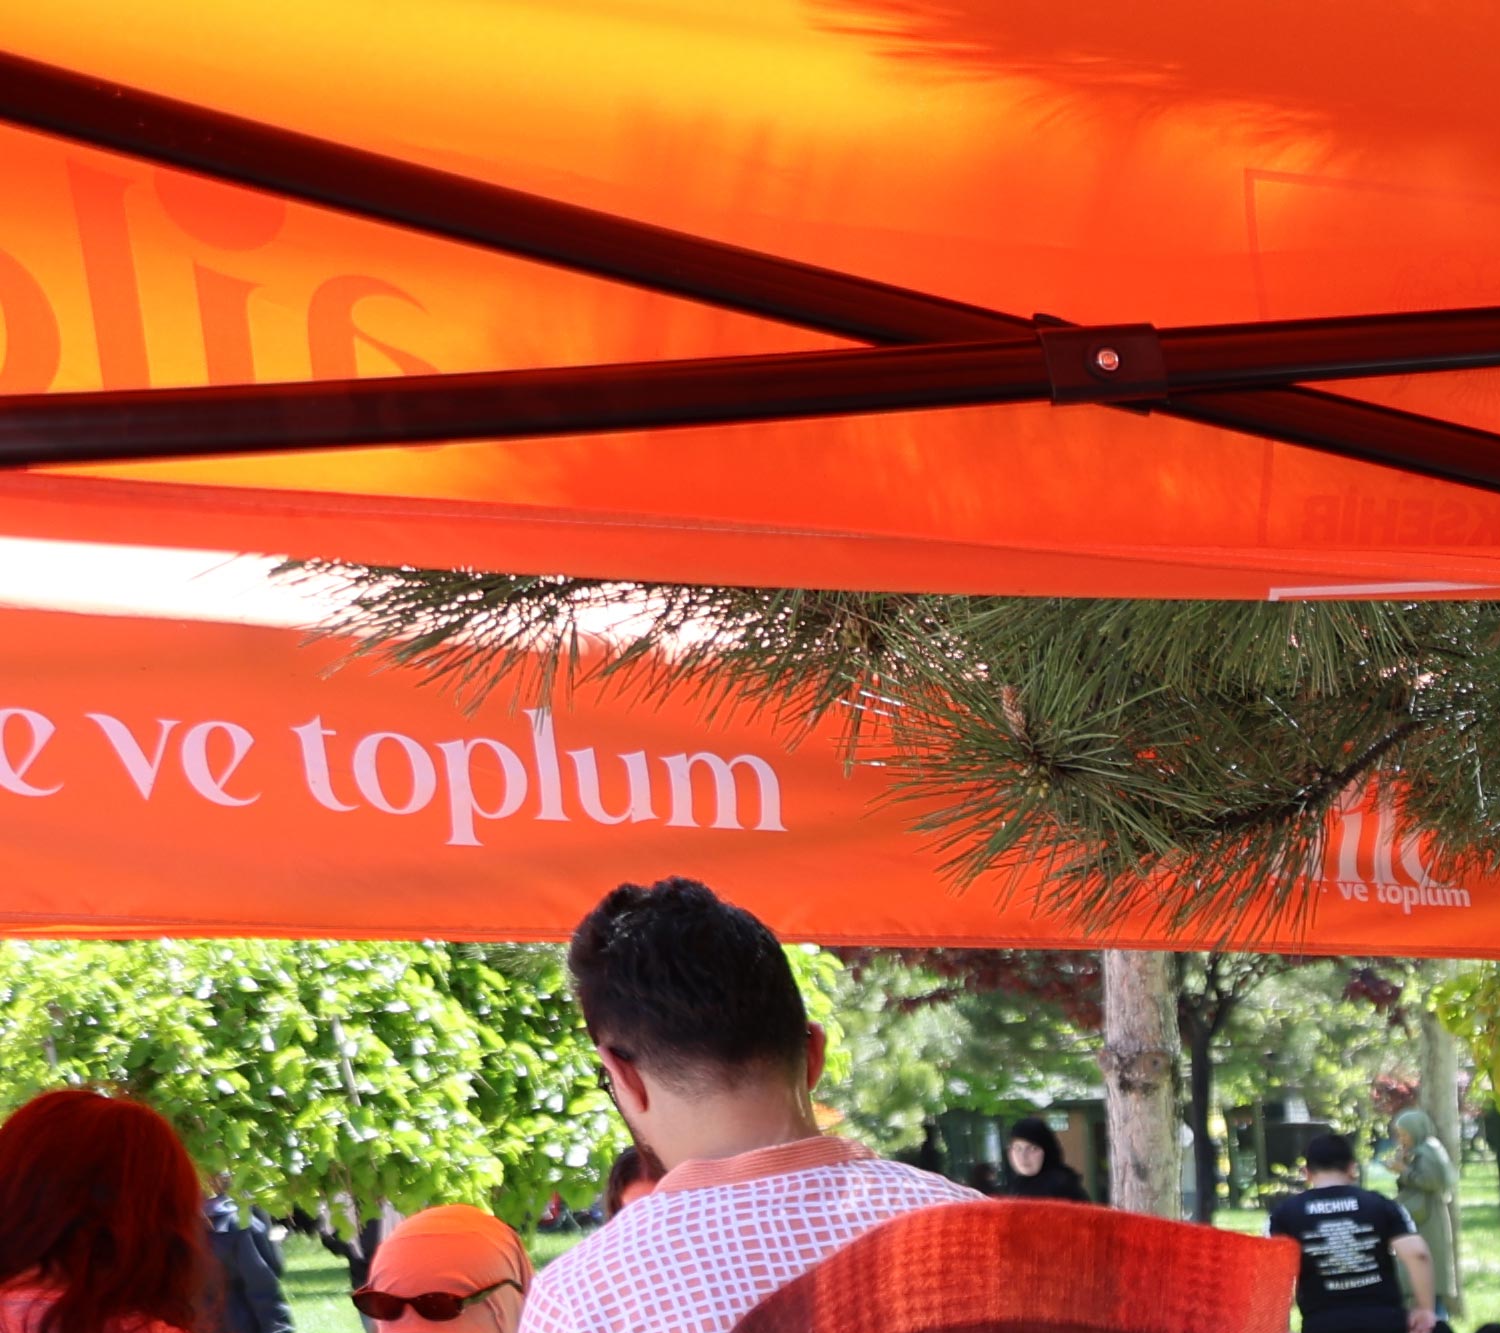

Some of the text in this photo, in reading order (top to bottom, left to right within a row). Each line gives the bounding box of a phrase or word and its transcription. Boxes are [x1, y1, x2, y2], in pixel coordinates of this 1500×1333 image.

[86, 713, 261, 806] ve
[291, 708, 788, 846] toplum
[1339, 882, 1472, 915] ve toplum
